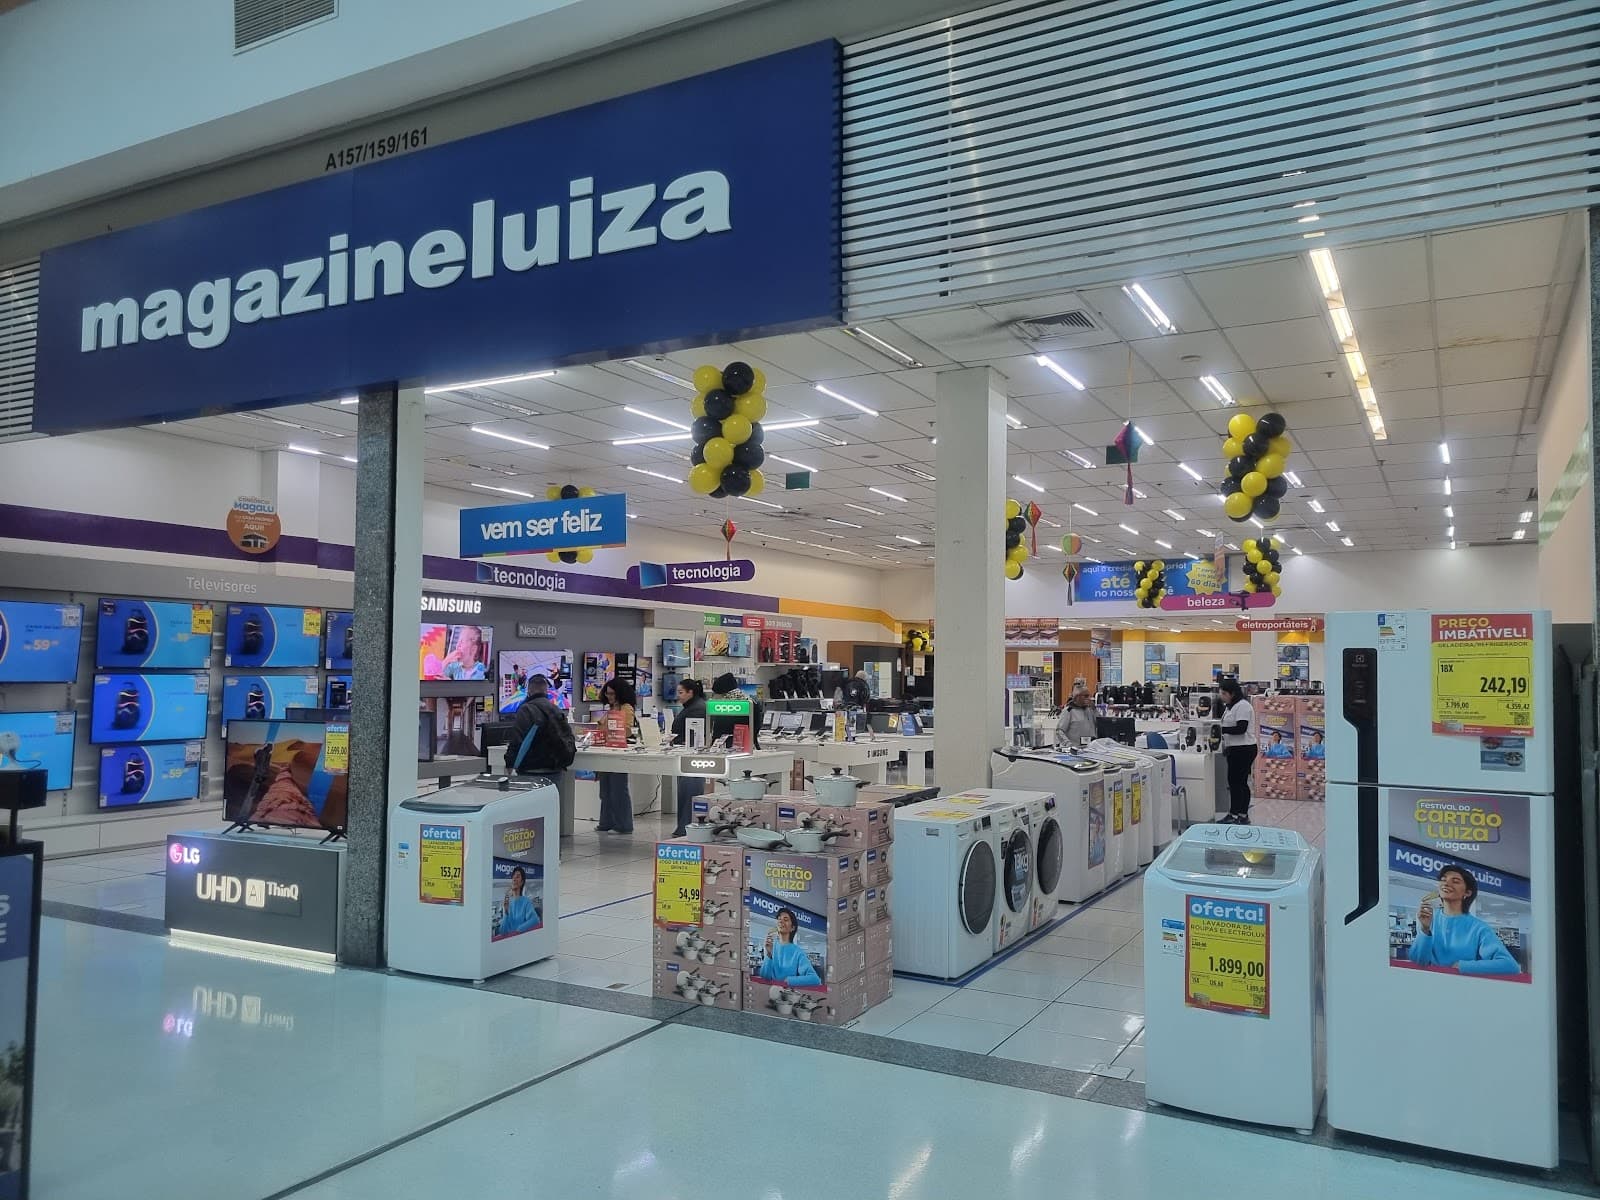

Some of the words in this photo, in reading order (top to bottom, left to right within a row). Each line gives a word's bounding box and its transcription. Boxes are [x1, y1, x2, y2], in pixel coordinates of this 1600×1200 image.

[325, 126, 429, 171] A157/159/161
[80, 170, 732, 350] magazineluiza
[481, 519, 522, 541] vem
[526, 514, 556, 536] ser
[561, 508, 603, 532] feliz
[494, 565, 567, 592] tecnologia
[672, 563, 741, 581] tecnologia
[186, 576, 258, 594] Televisores
[1101, 573, 1130, 589] até
[1110, 588, 1134, 597] noss
[420, 597, 482, 615] SAMSUNG
[1187, 596, 1225, 607] beleza
[519, 624, 537, 637] Neo
[538, 625, 558, 637] QLED
[1242, 619, 1309, 631] eletroportáteis
[1439, 617, 1489, 630] PREÇO
[1439, 626, 1527, 640] IMBATÍVEL!
[1440, 664, 1454, 673] 18X
[1480, 677, 1527, 697] 242,19
[714, 704, 742, 713] oppo
[691, 759, 716, 769] oppo
[422, 827, 462, 840] oferta!
[183, 847, 200, 864] LG
[659, 846, 701, 860] oferta!
[440, 866, 461, 880] 153,27
[196, 872, 242, 903] UHD
[266, 881, 299, 901] ThinQ
[679, 887, 700, 903] 54,99
[1191, 901, 1265, 922] oferta!
[1203, 920, 1242, 930] LAVADORA
[1220, 928, 1266, 938] ELECTROLUX
[1208, 956, 1264, 978] 1.899,00
